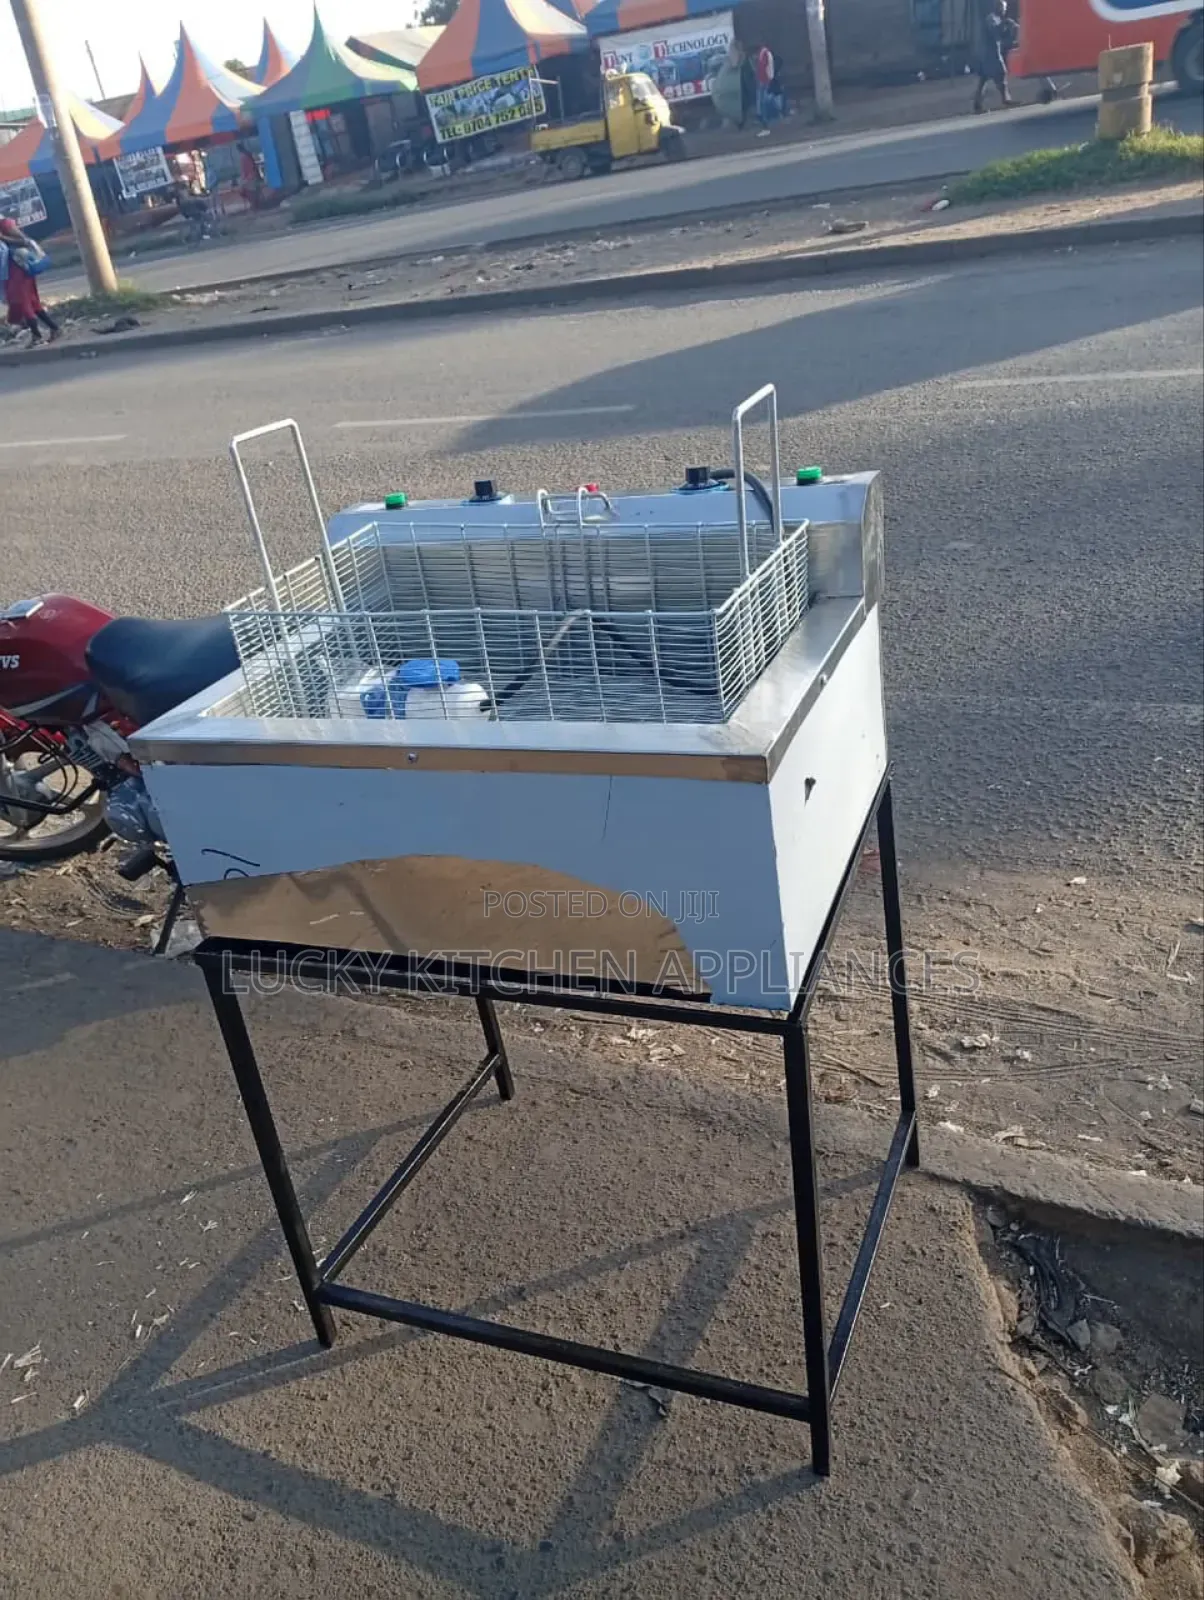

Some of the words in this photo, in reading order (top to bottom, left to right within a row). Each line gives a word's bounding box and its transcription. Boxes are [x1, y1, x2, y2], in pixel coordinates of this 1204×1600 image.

[652, 33, 730, 59] TECHNOLOGY
[429, 89, 455, 108] FAIR
[457, 77, 492, 98] PRICE
